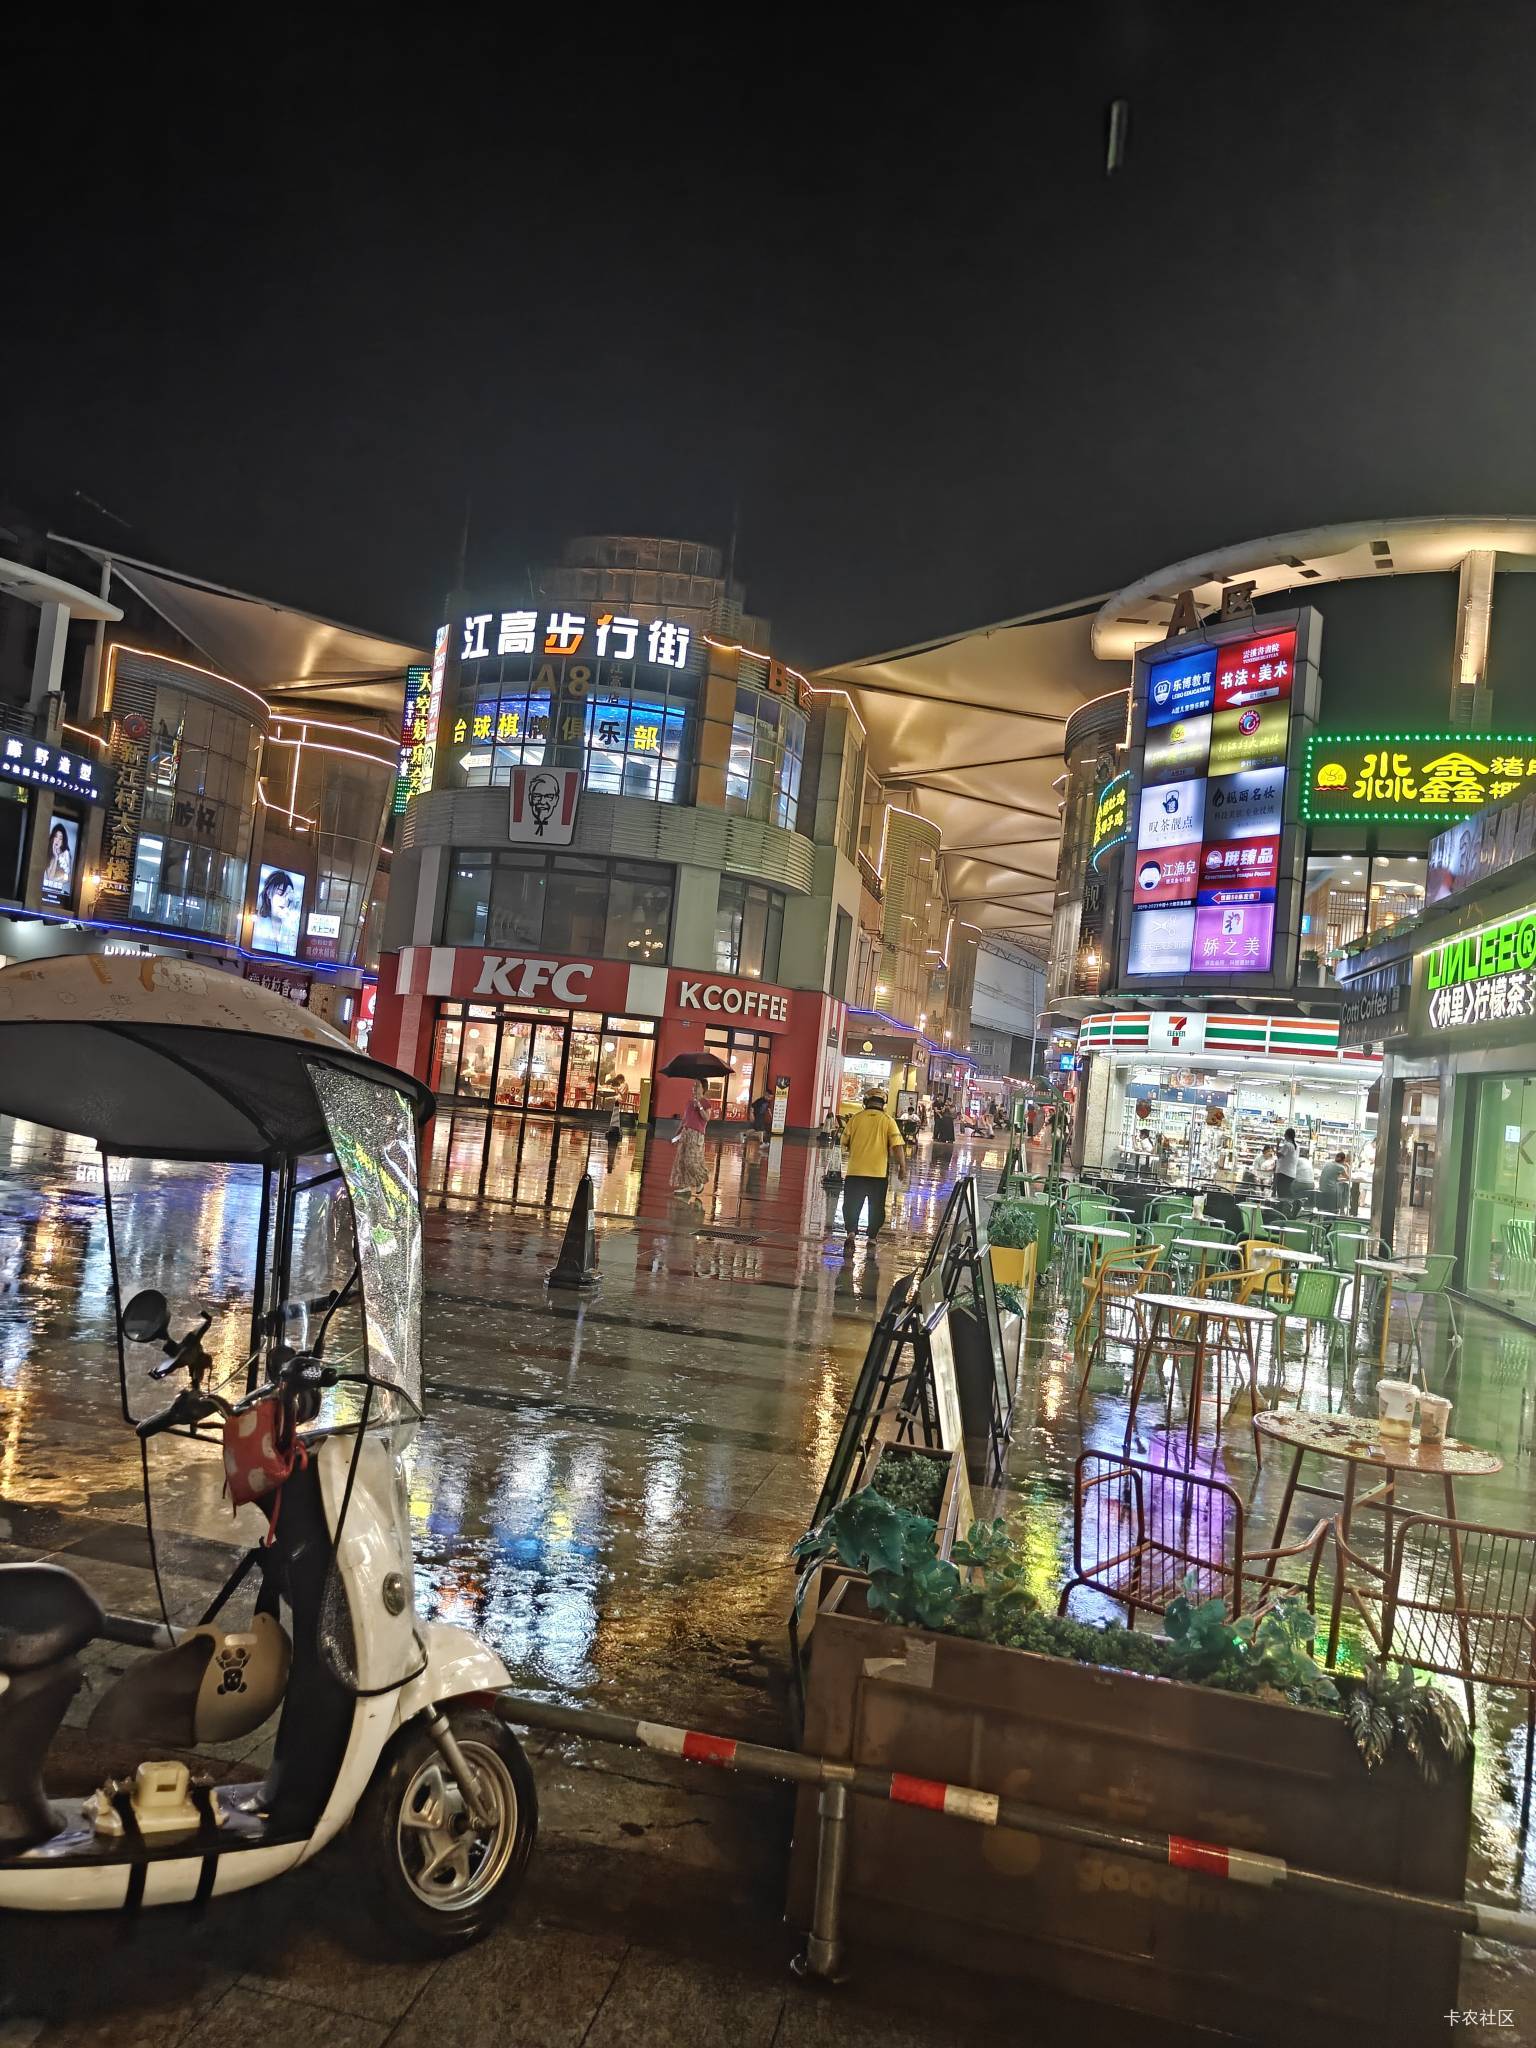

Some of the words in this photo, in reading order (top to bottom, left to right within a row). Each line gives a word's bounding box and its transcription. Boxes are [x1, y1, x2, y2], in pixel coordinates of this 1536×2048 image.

[461, 611, 690, 669] 江高步行街
[531, 663, 592, 697] A8
[1172, 671, 1212, 692] 乐博教育
[1352, 751, 1489, 803] 淼鑫
[1202, 936, 1261, 958] 娇之美
[472, 955, 594, 1003] KFC
[679, 980, 789, 1024] KCOFFEE
[1341, 999, 1360, 1025] Cotti
[1360, 991, 1388, 1020] Coffee
[1168, 1016, 1188, 1047] 7
